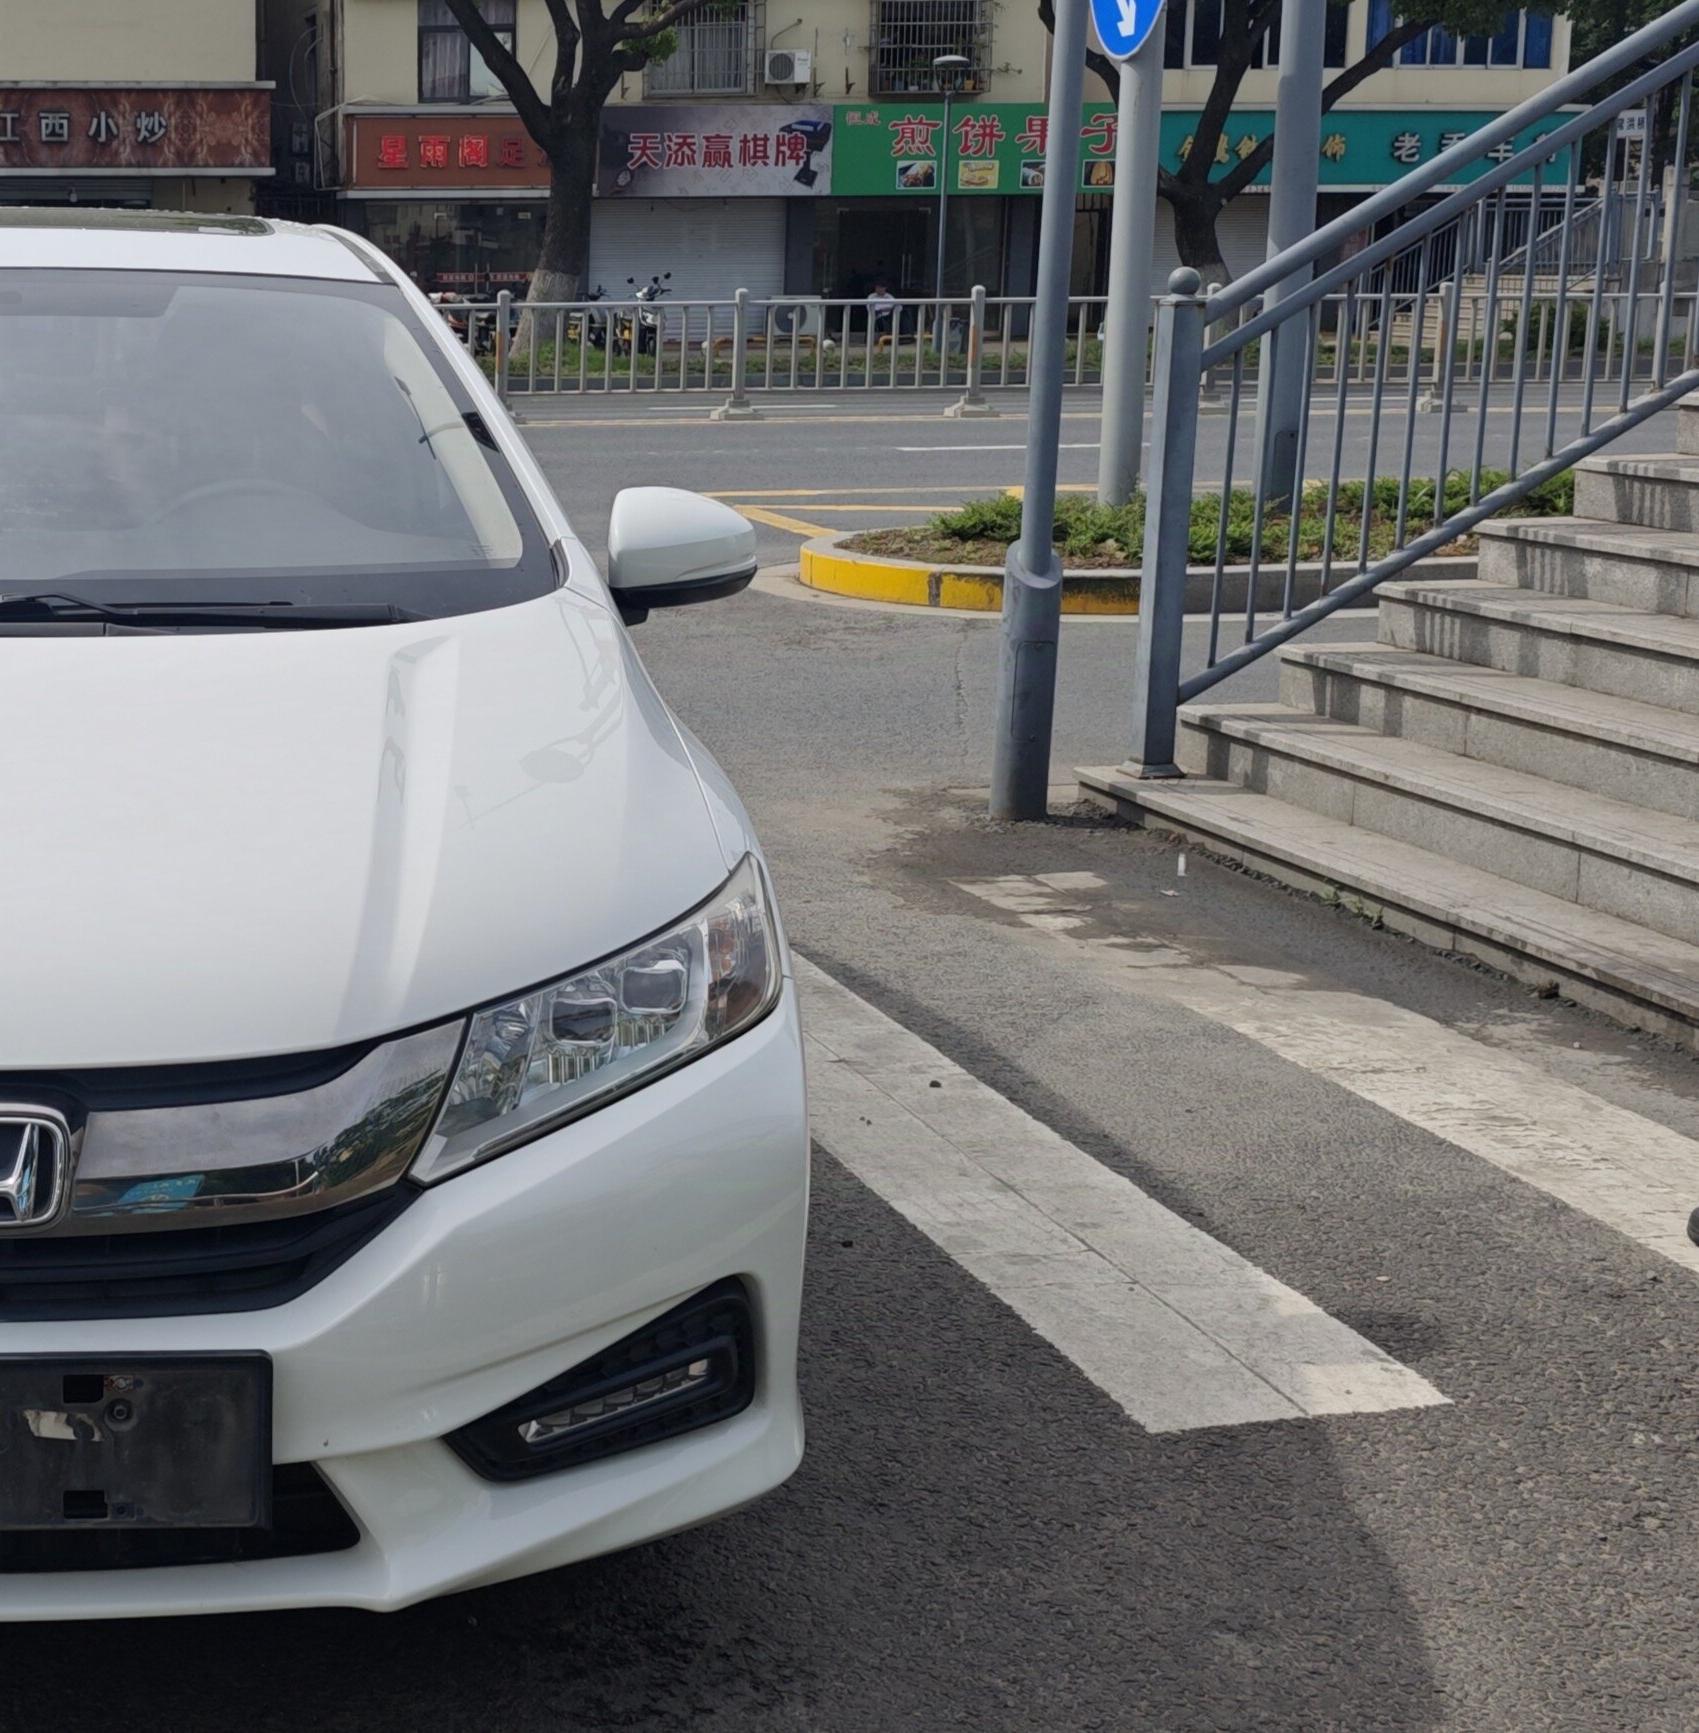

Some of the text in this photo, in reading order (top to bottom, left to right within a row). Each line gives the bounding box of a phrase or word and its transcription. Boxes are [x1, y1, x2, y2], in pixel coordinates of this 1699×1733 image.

[377, 134, 550, 169] 星雨阁足
[626, 132, 808, 170] 天添赢棋牌
